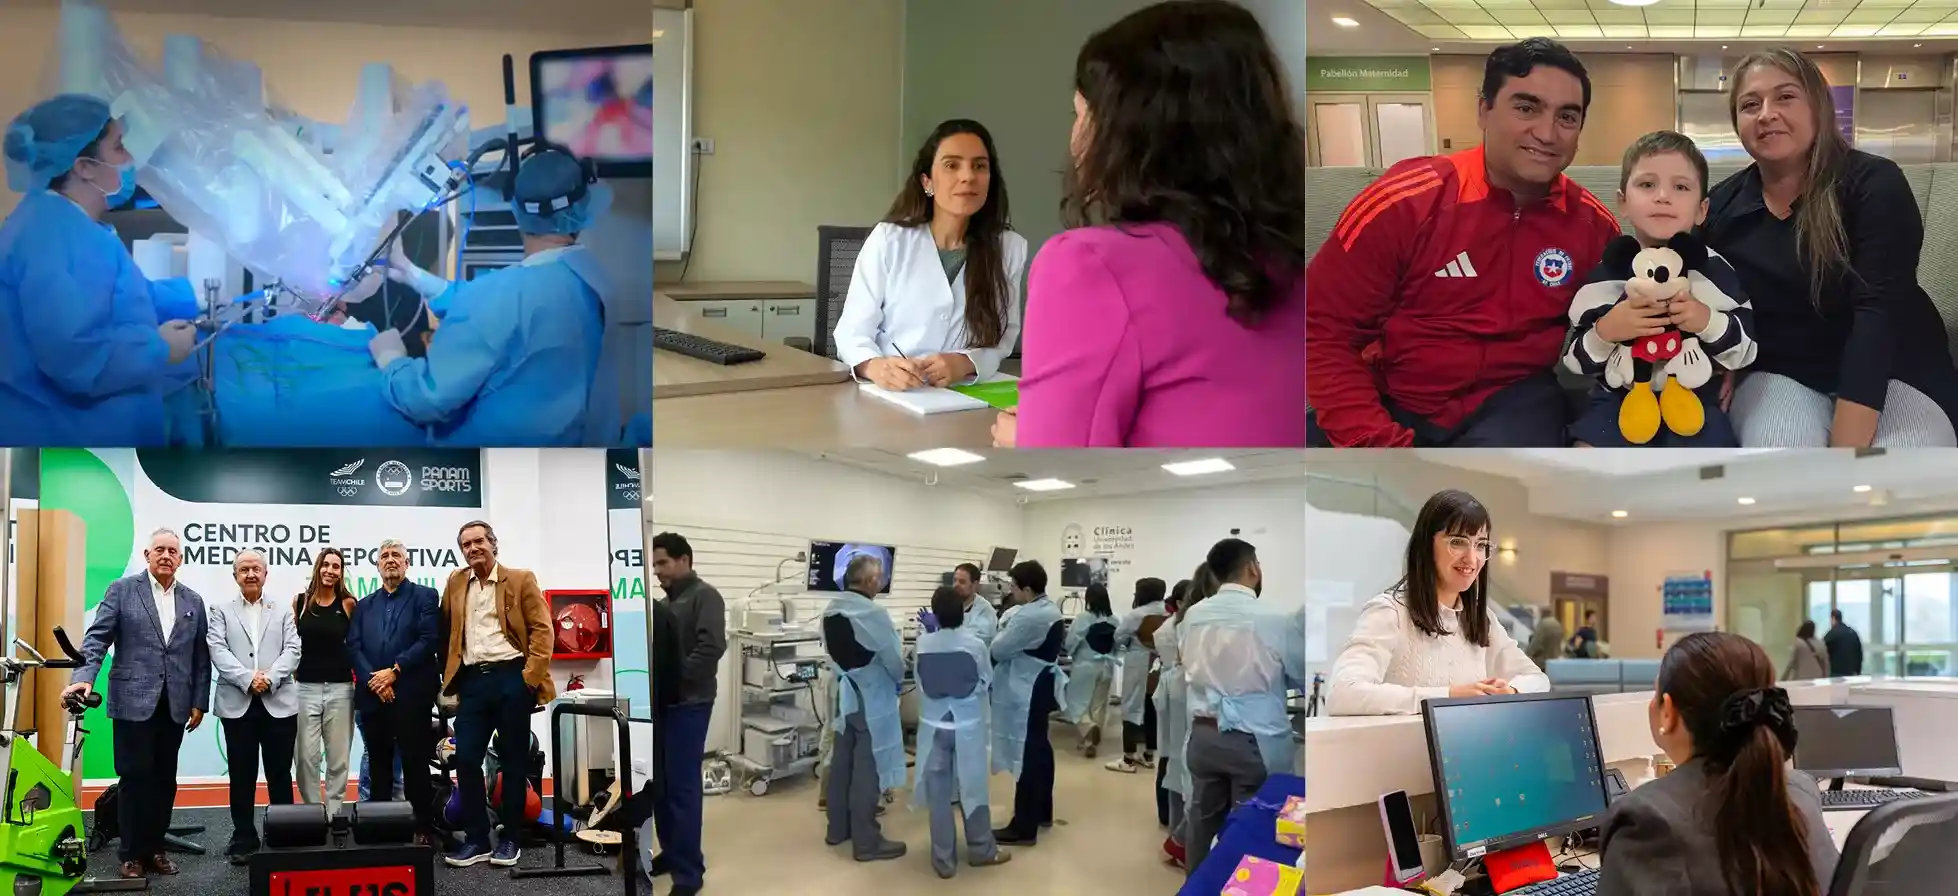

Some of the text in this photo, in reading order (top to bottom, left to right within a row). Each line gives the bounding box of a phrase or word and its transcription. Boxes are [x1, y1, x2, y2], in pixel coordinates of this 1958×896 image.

[1320, 68, 1408, 78] Pabellón Maternidad
[422, 466, 470, 479] PANAM
[420, 479, 472, 492] SPORTS
[184, 522, 331, 544] CENTRO DE
[184, 546, 313, 566] MEDINA
